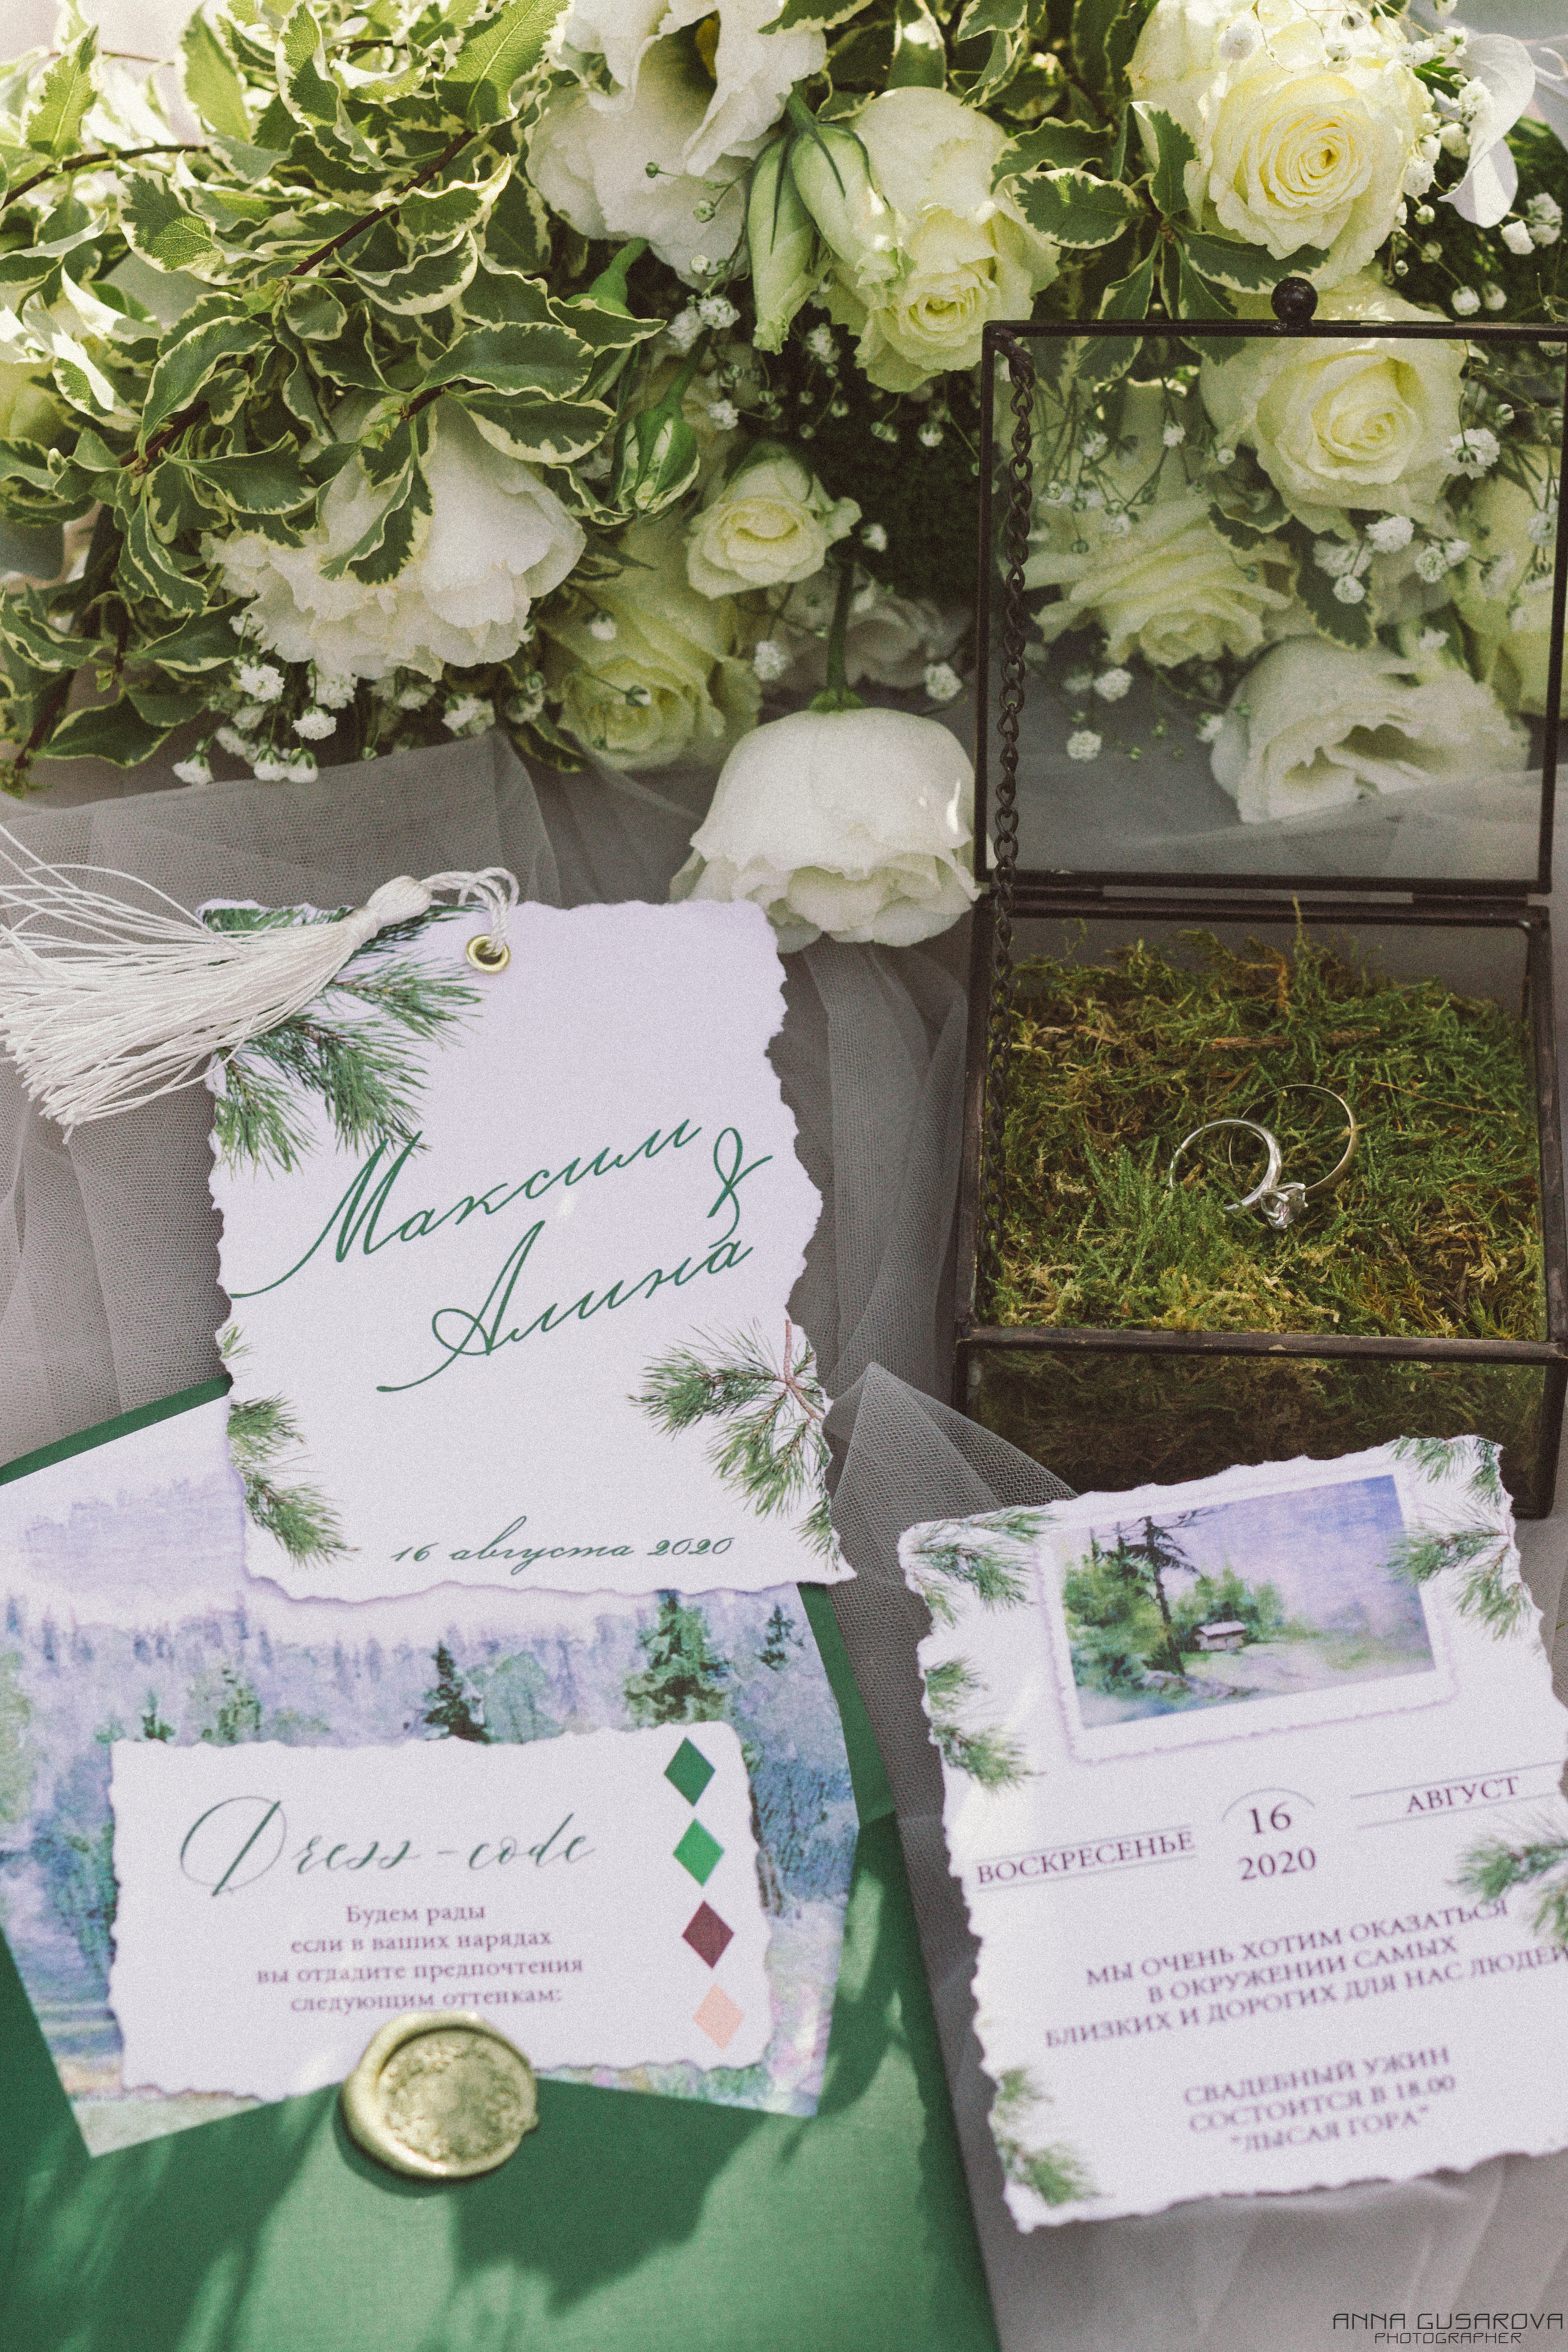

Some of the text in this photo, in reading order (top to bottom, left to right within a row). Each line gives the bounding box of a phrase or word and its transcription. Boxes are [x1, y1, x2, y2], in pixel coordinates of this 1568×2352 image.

[229, 1118, 703, 1300] Максим
[375, 1219, 754, 1392] Алина
[391, 1515, 736, 1575] 16 августа 2020
[977, 1776, 1521, 1885] ВОСКРЕСЕНЬЕ 16 АВГУСТ
[1238, 1847, 1317, 1881] 2020
[290, 1929, 552, 1954] если в ваших нарядах
[346, 1904, 486, 1926] Будем рады
[1086, 1898, 1509, 1986] МЫ ОЧЕНЬ ХОТИМ ОКАЗАТЬСЯ
[257, 1958, 584, 1985] вы отдадите предпочтения
[1148, 1936, 1459, 2003] В ОКРУЖЕНИИ САМЫХ
[290, 1988, 563, 2014] следующим оттенкам:
[1046, 2012, 1172, 2048] БЛИЗКИХ
[1180, 2008, 1199, 2027] И
[1207, 1986, 1336, 2026] ДОРОГИХ
[1345, 1977, 1396, 2000] ДЛЯ
[1404, 1962, 1464, 1989] НАС
[1183, 2046, 1450, 2106] СВАДЕБНЫЙ УЖИН
[1189, 2074, 1457, 2133] СОСТОИТСЯ В 18.00
